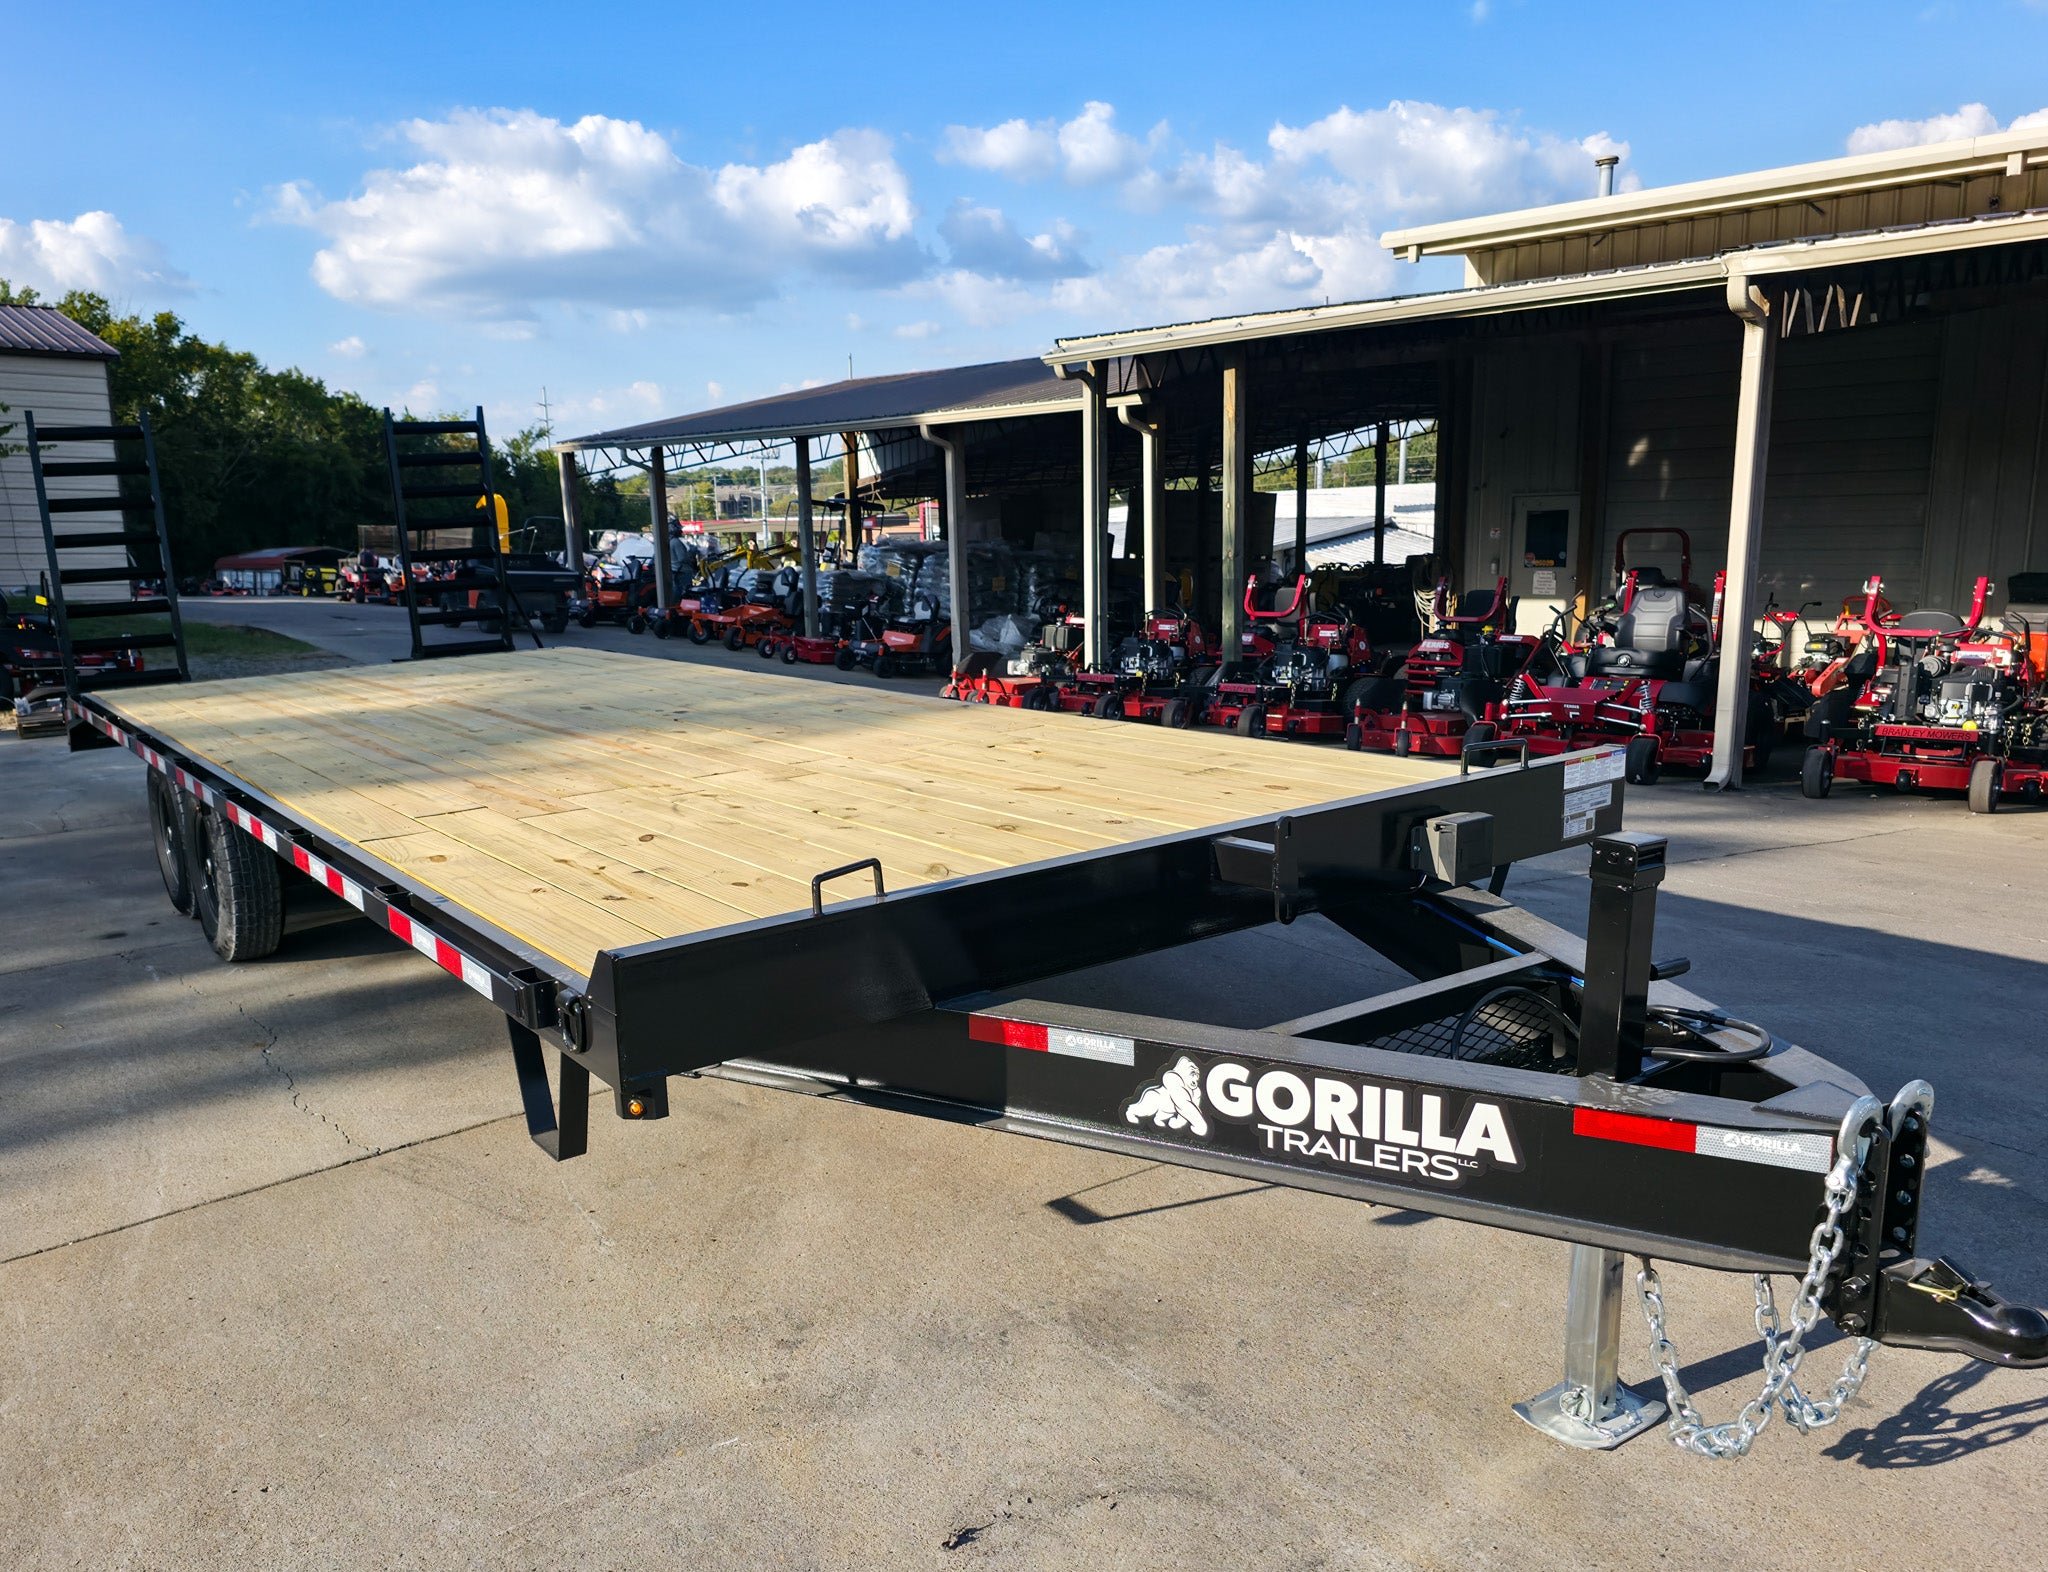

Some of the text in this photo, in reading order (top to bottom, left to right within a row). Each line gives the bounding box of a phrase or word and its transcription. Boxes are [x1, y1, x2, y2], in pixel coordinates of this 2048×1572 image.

[1881, 727, 1972, 740] BRADLEY MOWERS
[1077, 1036, 1116, 1050] GORILLA
[1206, 1063, 1517, 1164] GORILLA
[1258, 1124, 1478, 1180] TRAILERS LLC
[1741, 1135, 1801, 1153] GORILLA
